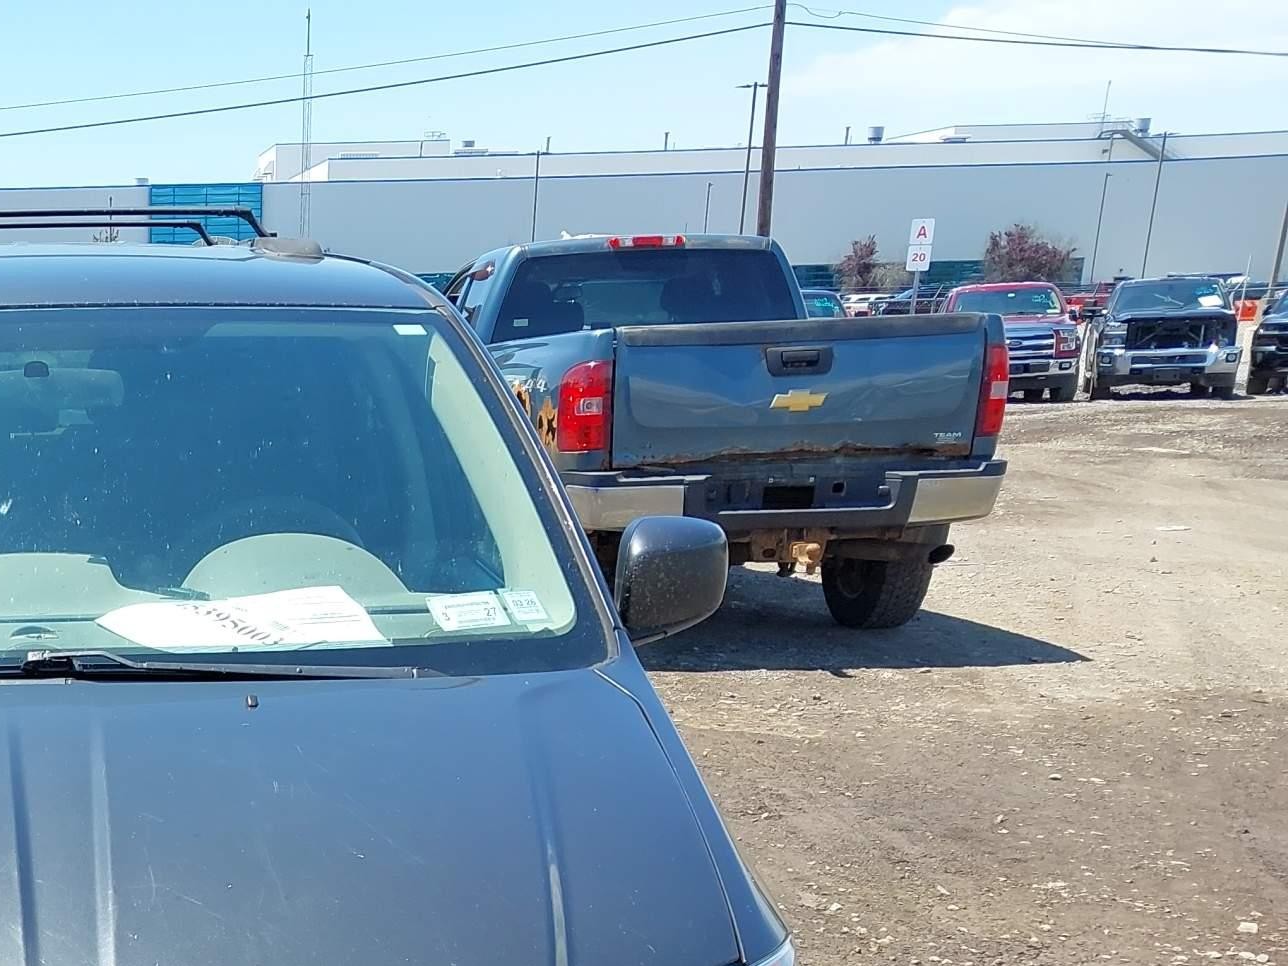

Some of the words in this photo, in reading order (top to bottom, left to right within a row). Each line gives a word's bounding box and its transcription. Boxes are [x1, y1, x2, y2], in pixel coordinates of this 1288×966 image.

[916, 225, 928, 239] A
[912, 252, 926, 262] 20
[483, 607, 497, 617] 27
